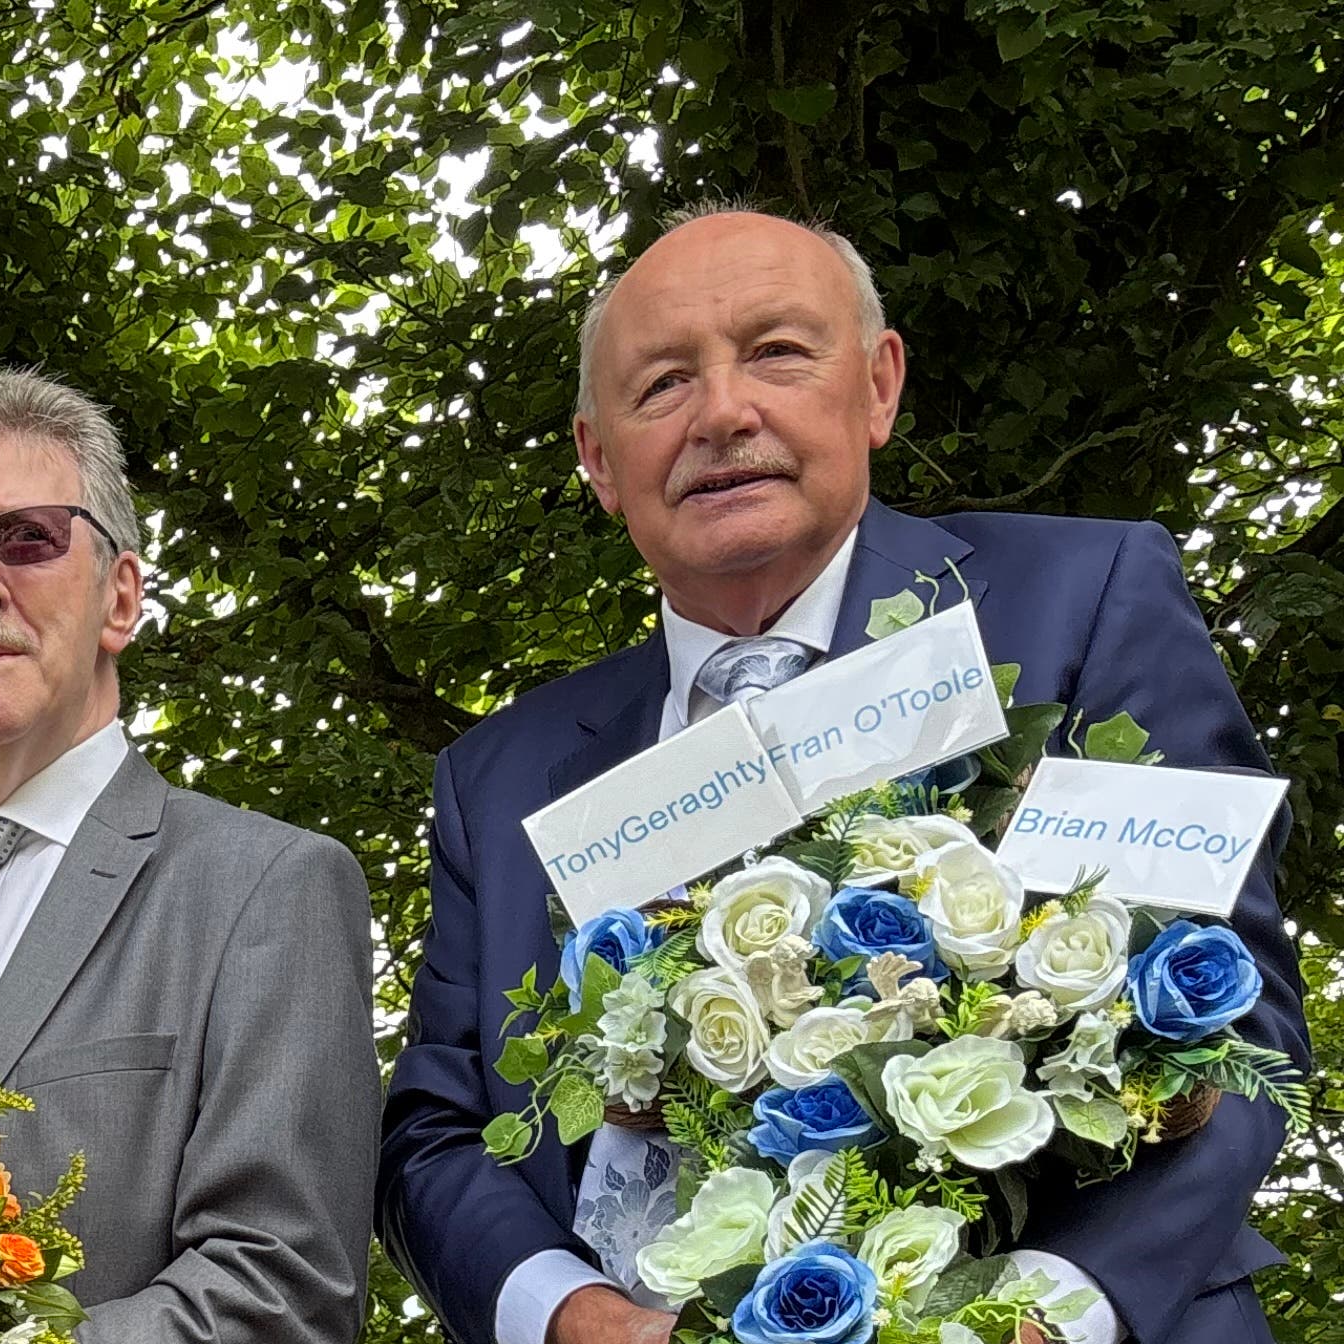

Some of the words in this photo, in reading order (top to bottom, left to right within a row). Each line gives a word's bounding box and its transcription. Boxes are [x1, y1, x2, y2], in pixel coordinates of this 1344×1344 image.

[765, 724, 843, 769] Fran
[854, 666, 985, 734] O'Toole
[1013, 807, 1107, 843] Brian
[1117, 817, 1252, 864] McCoy
